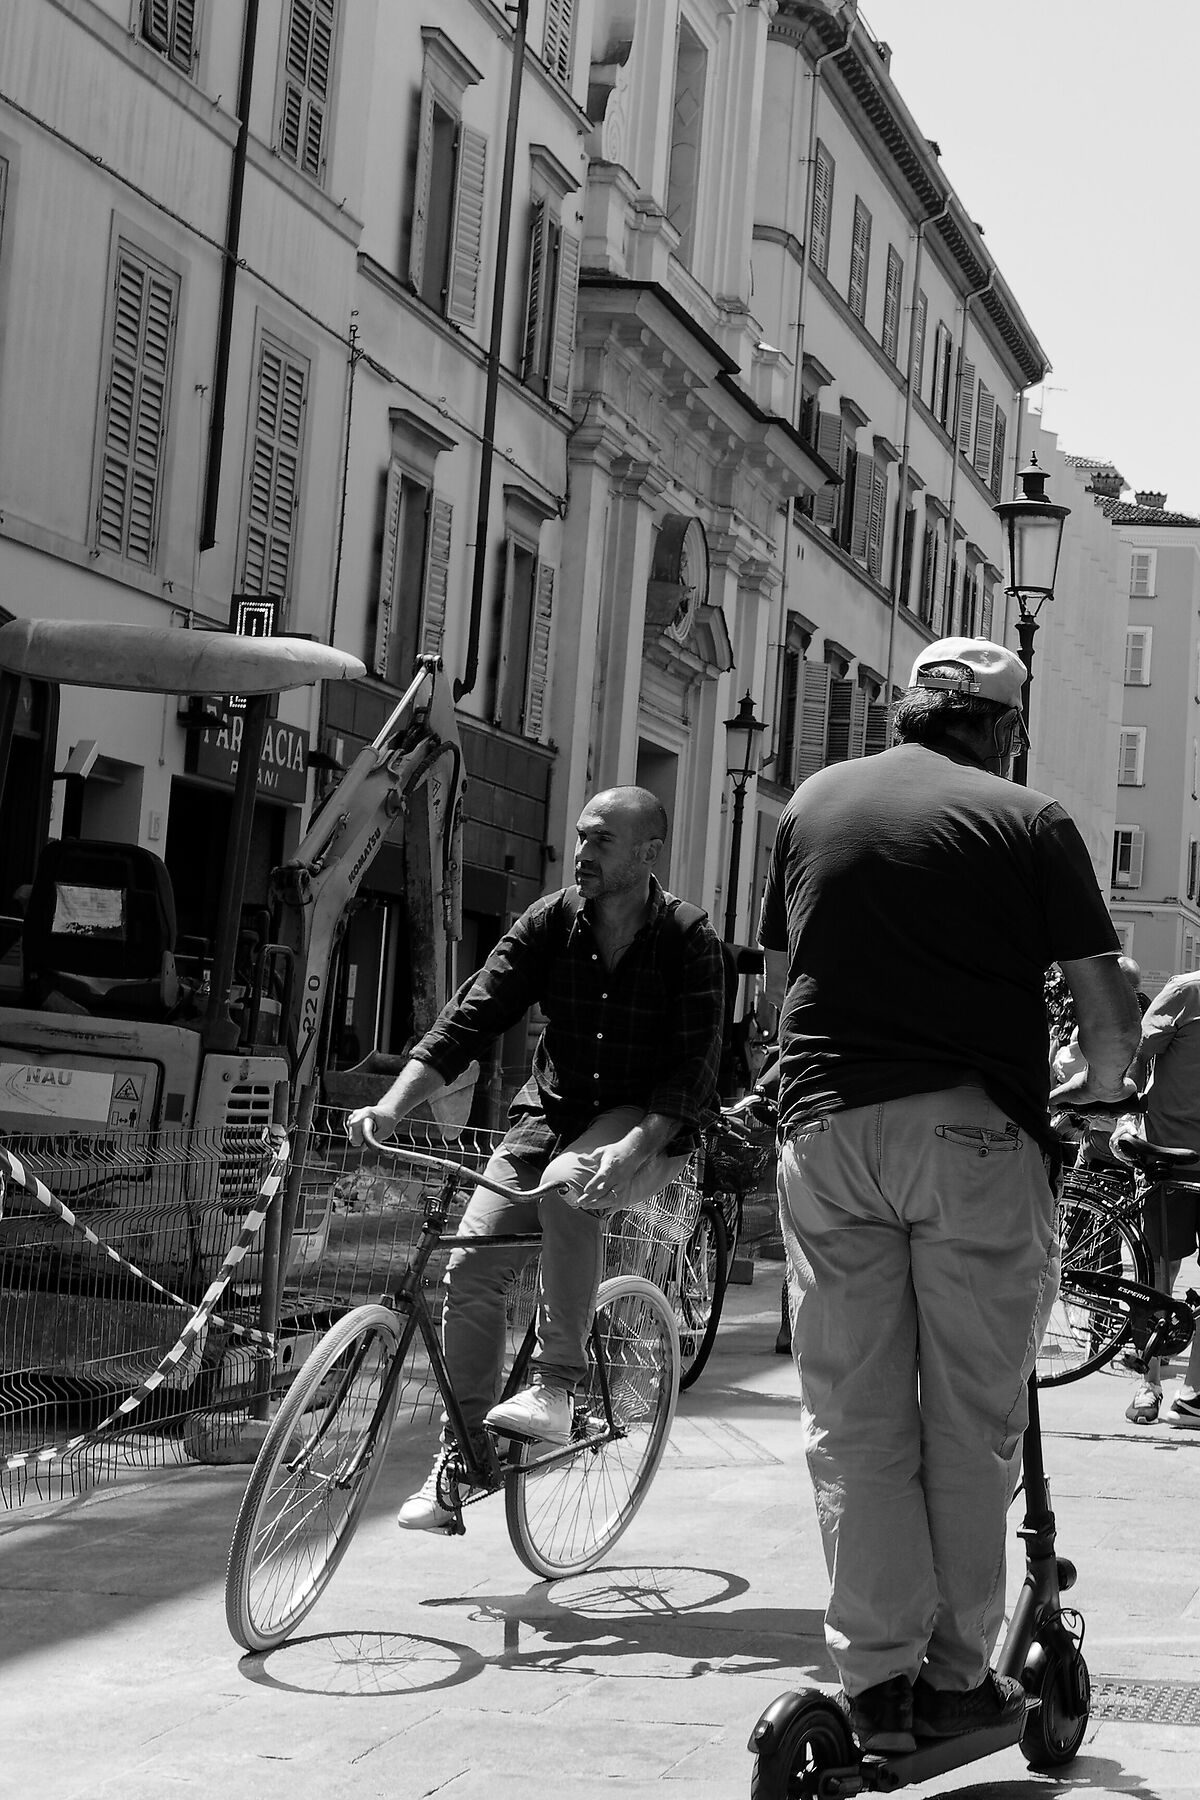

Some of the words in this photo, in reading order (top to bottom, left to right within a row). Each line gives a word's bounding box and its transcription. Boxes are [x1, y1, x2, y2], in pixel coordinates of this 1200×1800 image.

[204, 704, 304, 773] FARACIA
[348, 827, 381, 884] KOMATSU
[303, 975, 320, 1033] 220
[1118, 1286, 1150, 1302] ESPERIA
